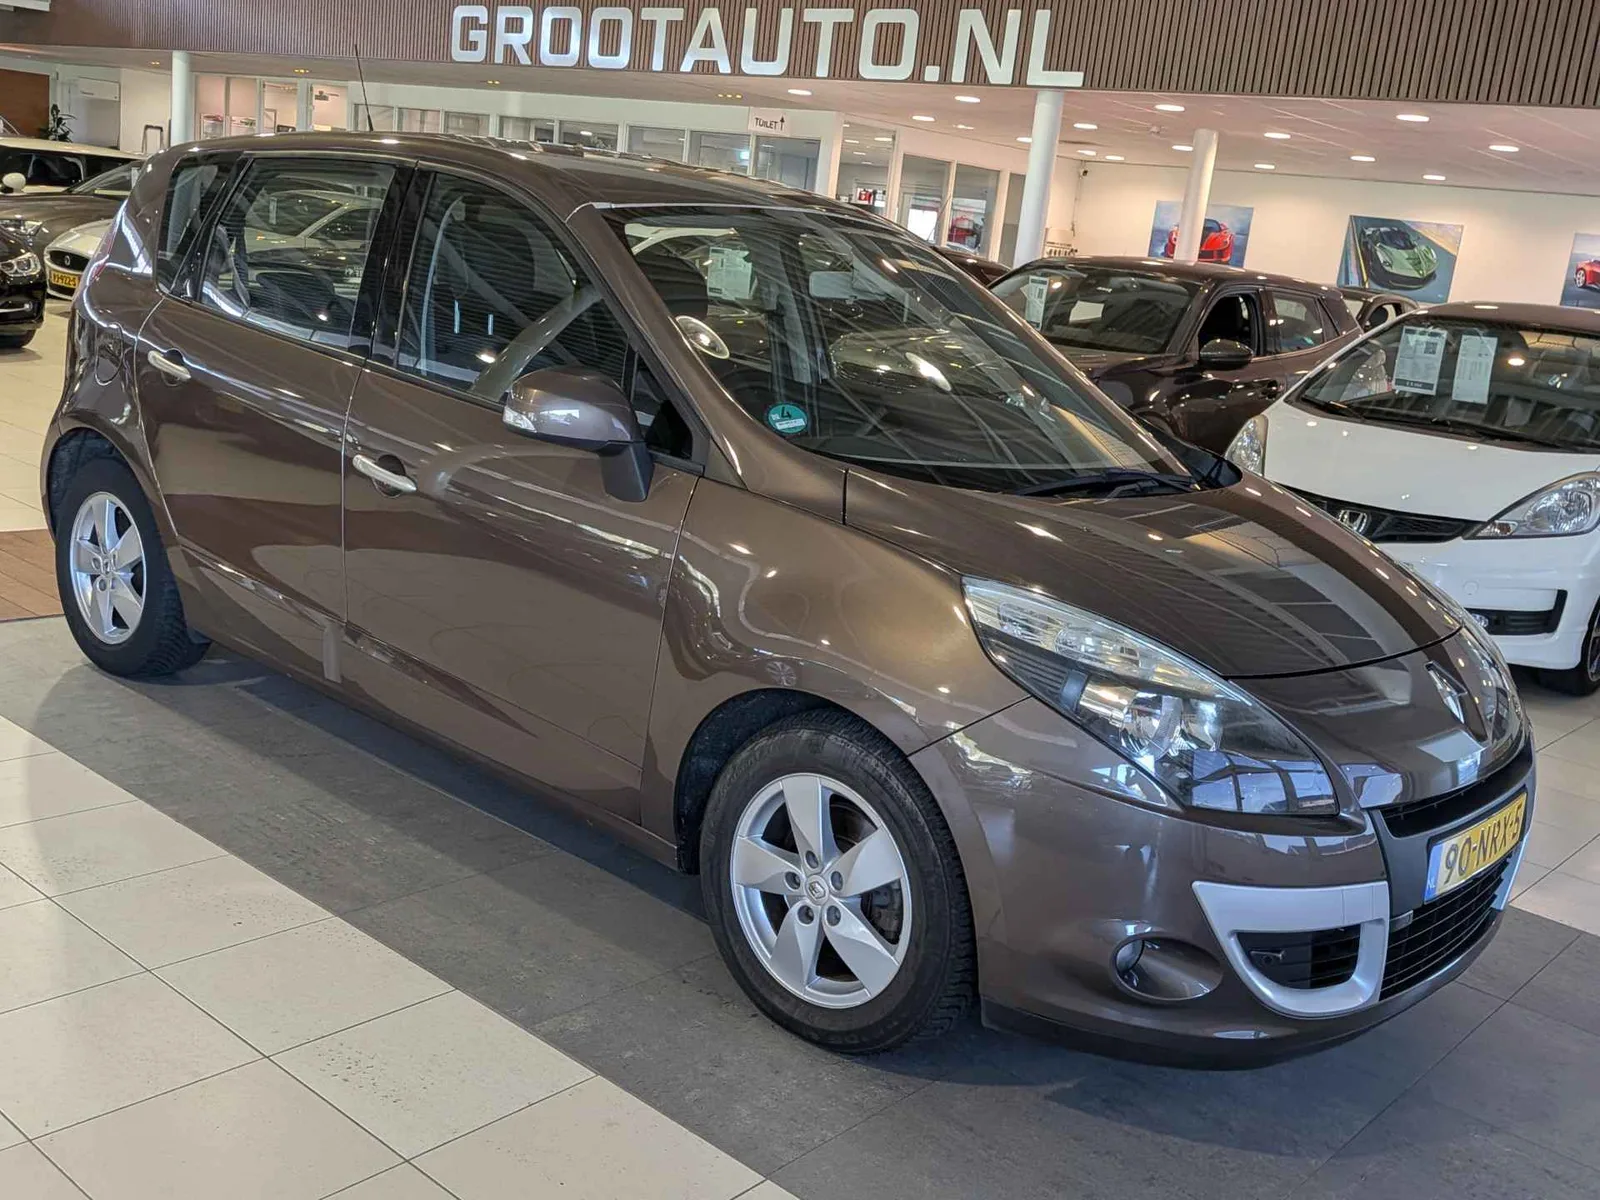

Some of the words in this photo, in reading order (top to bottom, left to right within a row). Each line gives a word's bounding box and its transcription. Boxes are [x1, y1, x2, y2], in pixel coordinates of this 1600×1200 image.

[452, 5, 1084, 87] GROOTAUTO.NL
[755, 117, 778, 130] TOILET
[1444, 802, 1523, 885] 90-NRX-5
